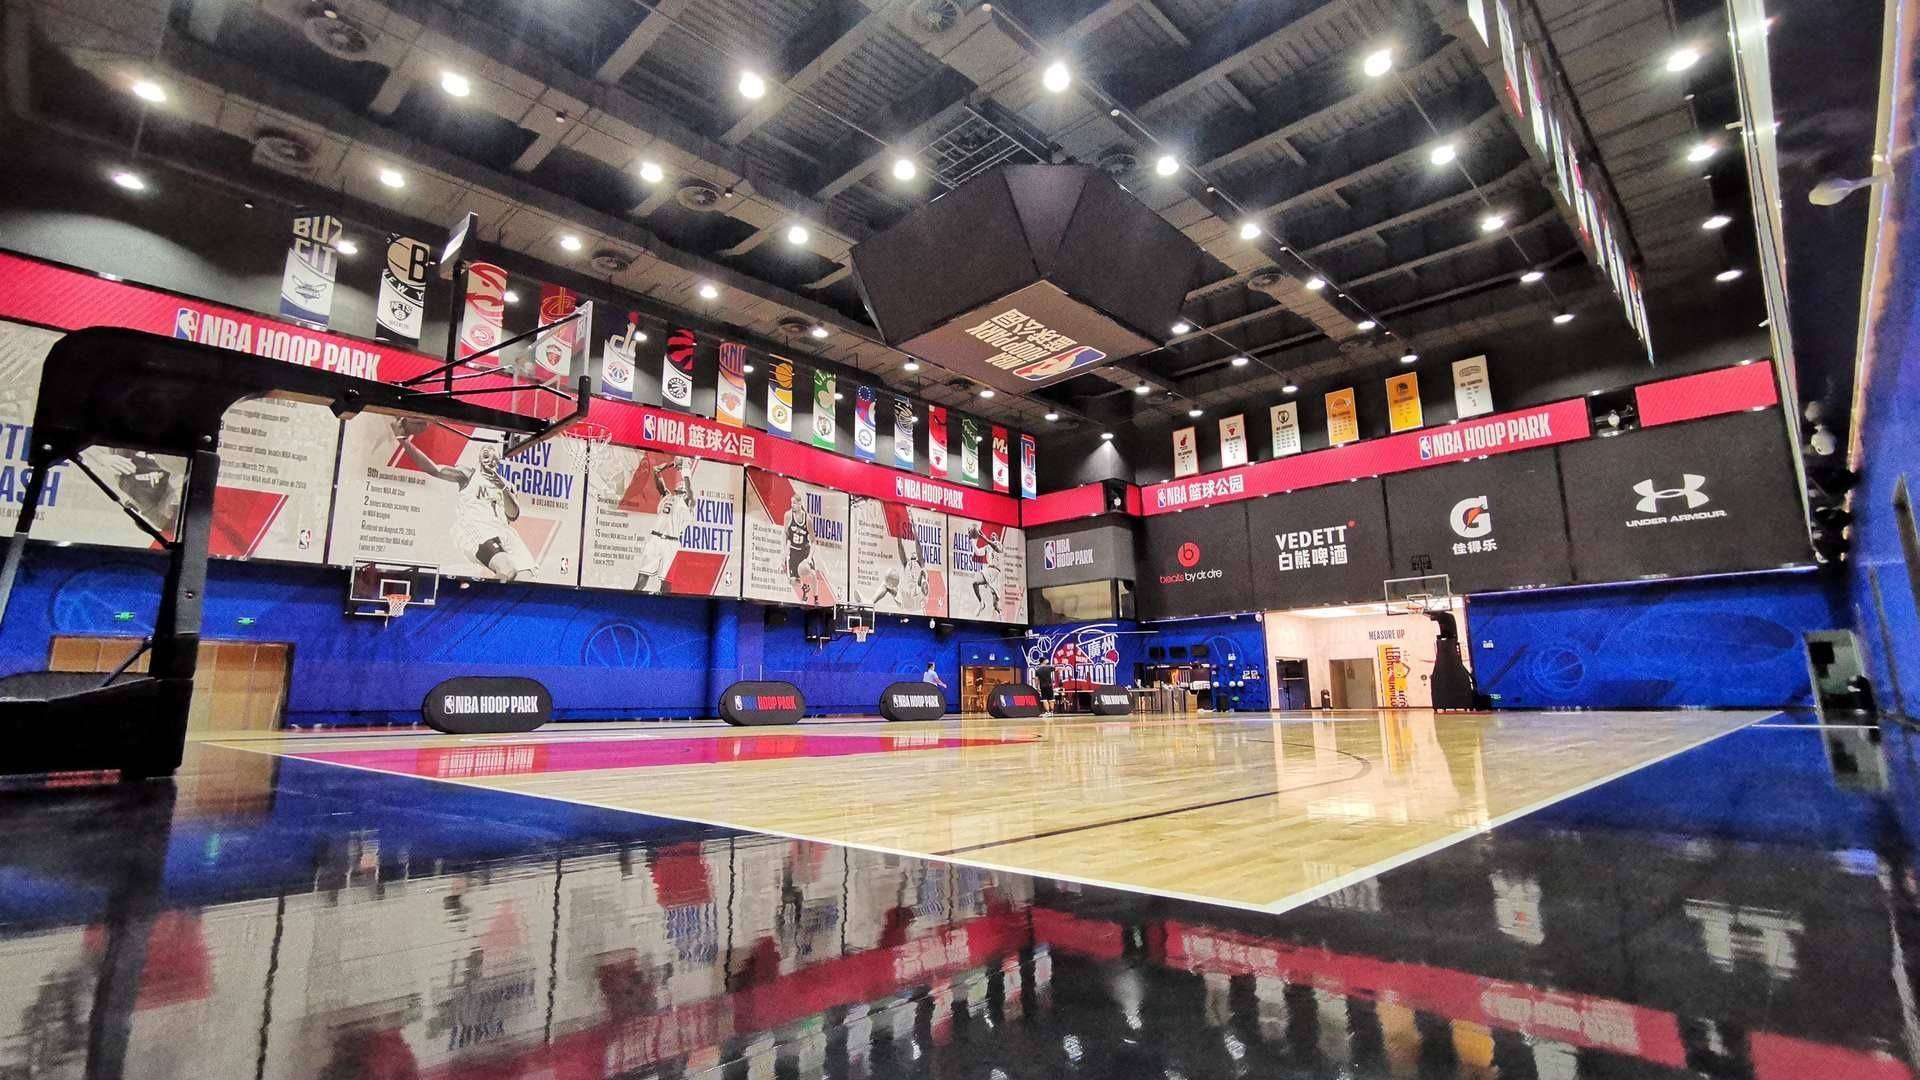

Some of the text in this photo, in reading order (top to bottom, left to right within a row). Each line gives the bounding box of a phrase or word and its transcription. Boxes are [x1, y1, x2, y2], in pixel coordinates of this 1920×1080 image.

[200, 313, 382, 381] NBA HOOP PARK
[964, 320, 1052, 363] HOOP PARK
[984, 351, 1028, 371] NBA
[656, 417, 755, 458] NBA 篮球公园
[1432, 412, 1552, 457] NBA HOOP PARK
[904, 478, 963, 510] NBA HOOP PARK
[1166, 474, 1244, 506] NBA 篮球公园
[696, 499, 734, 526] KEVIN
[806, 493, 823, 516] TIM
[813, 516, 843, 543] UNCAN
[1625, 510, 1727, 528] UNDER ARMOUR
[680, 525, 734, 553] ARNETT
[1056, 538, 1071, 554] NBA
[1275, 525, 1347, 551] VEDETT
[1452, 538, 1498, 555] 佳得乐
[1056, 548, 1094, 568] HOOP PARK
[1278, 544, 1348, 571] 白熊啤酒
[1368, 629, 1396, 641] MEASURE
[455, 696, 538, 713] NBA HOOP PARK
[757, 696, 777, 710] HOOP
[776, 696, 797, 710] PARK
